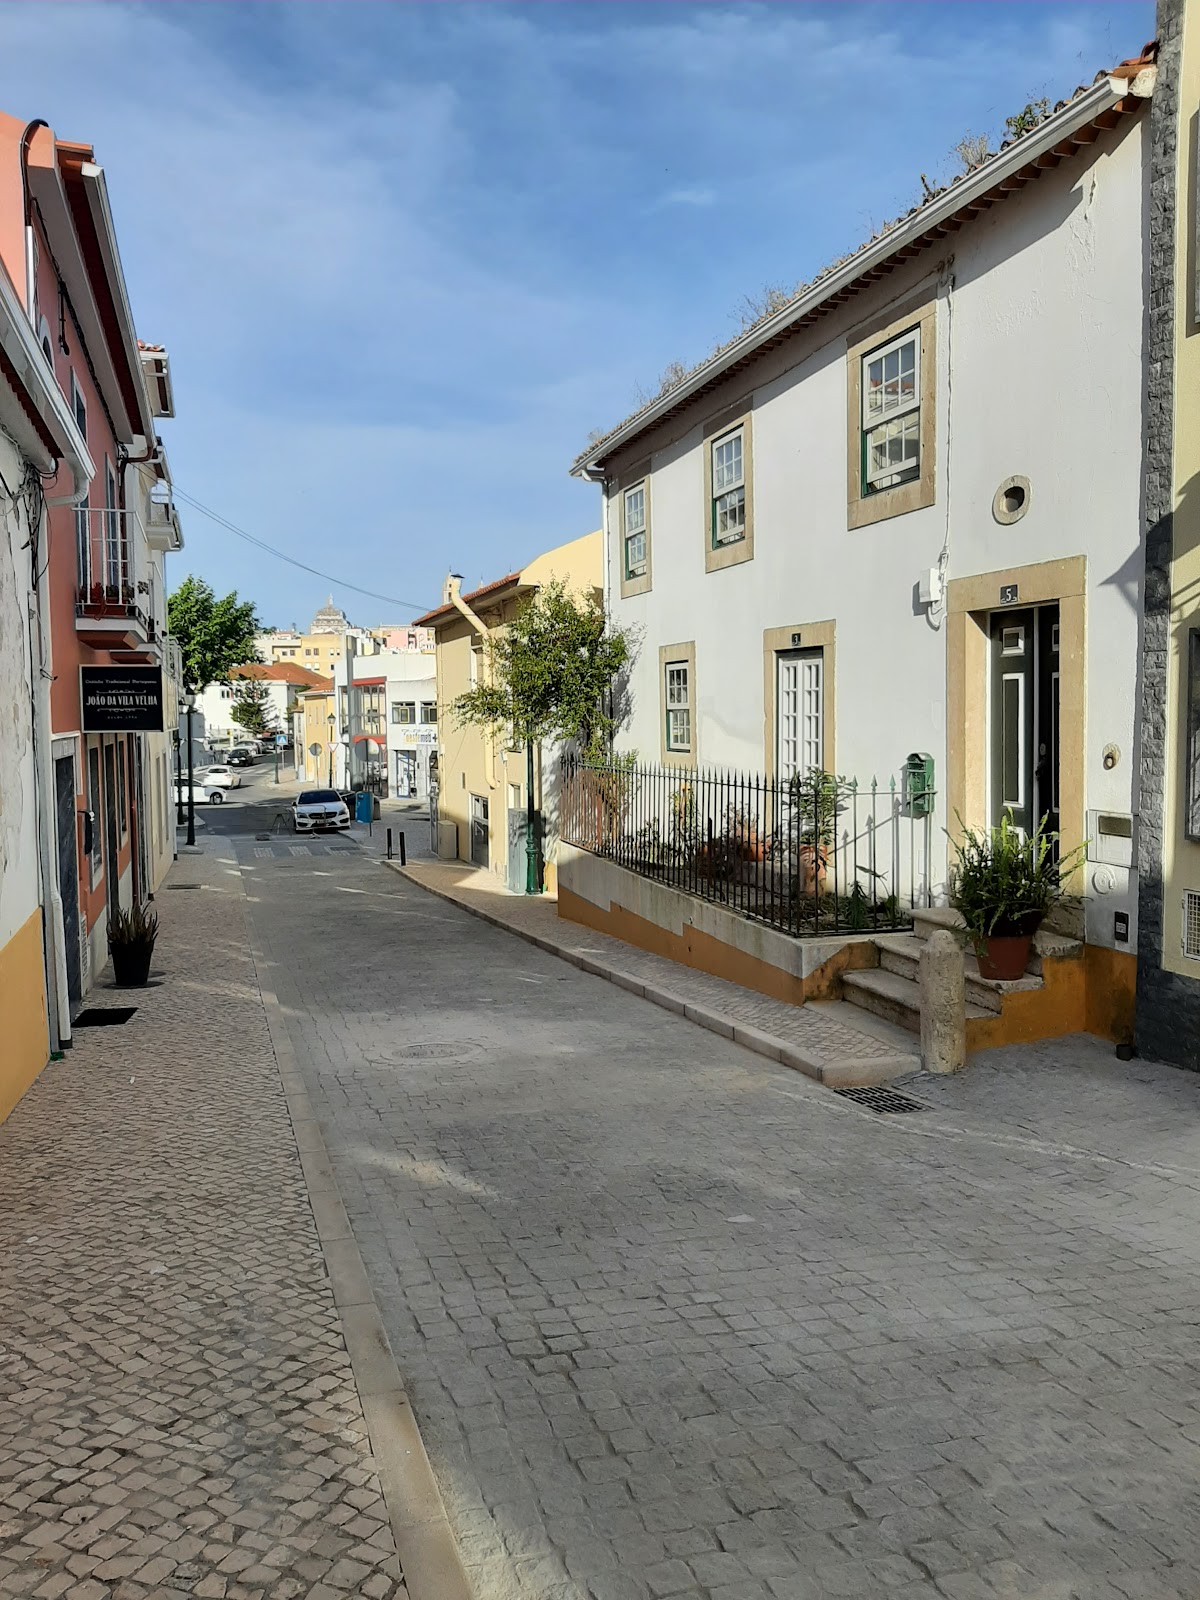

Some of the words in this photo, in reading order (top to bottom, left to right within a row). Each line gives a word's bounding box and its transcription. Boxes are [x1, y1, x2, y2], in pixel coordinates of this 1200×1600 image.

[1006, 588, 1012, 602] 5
[86, 694, 106, 706] JOÃO
[107, 695, 117, 706] DA
[117, 695, 134, 706] VILA
[134, 695, 158, 706] VELHA
